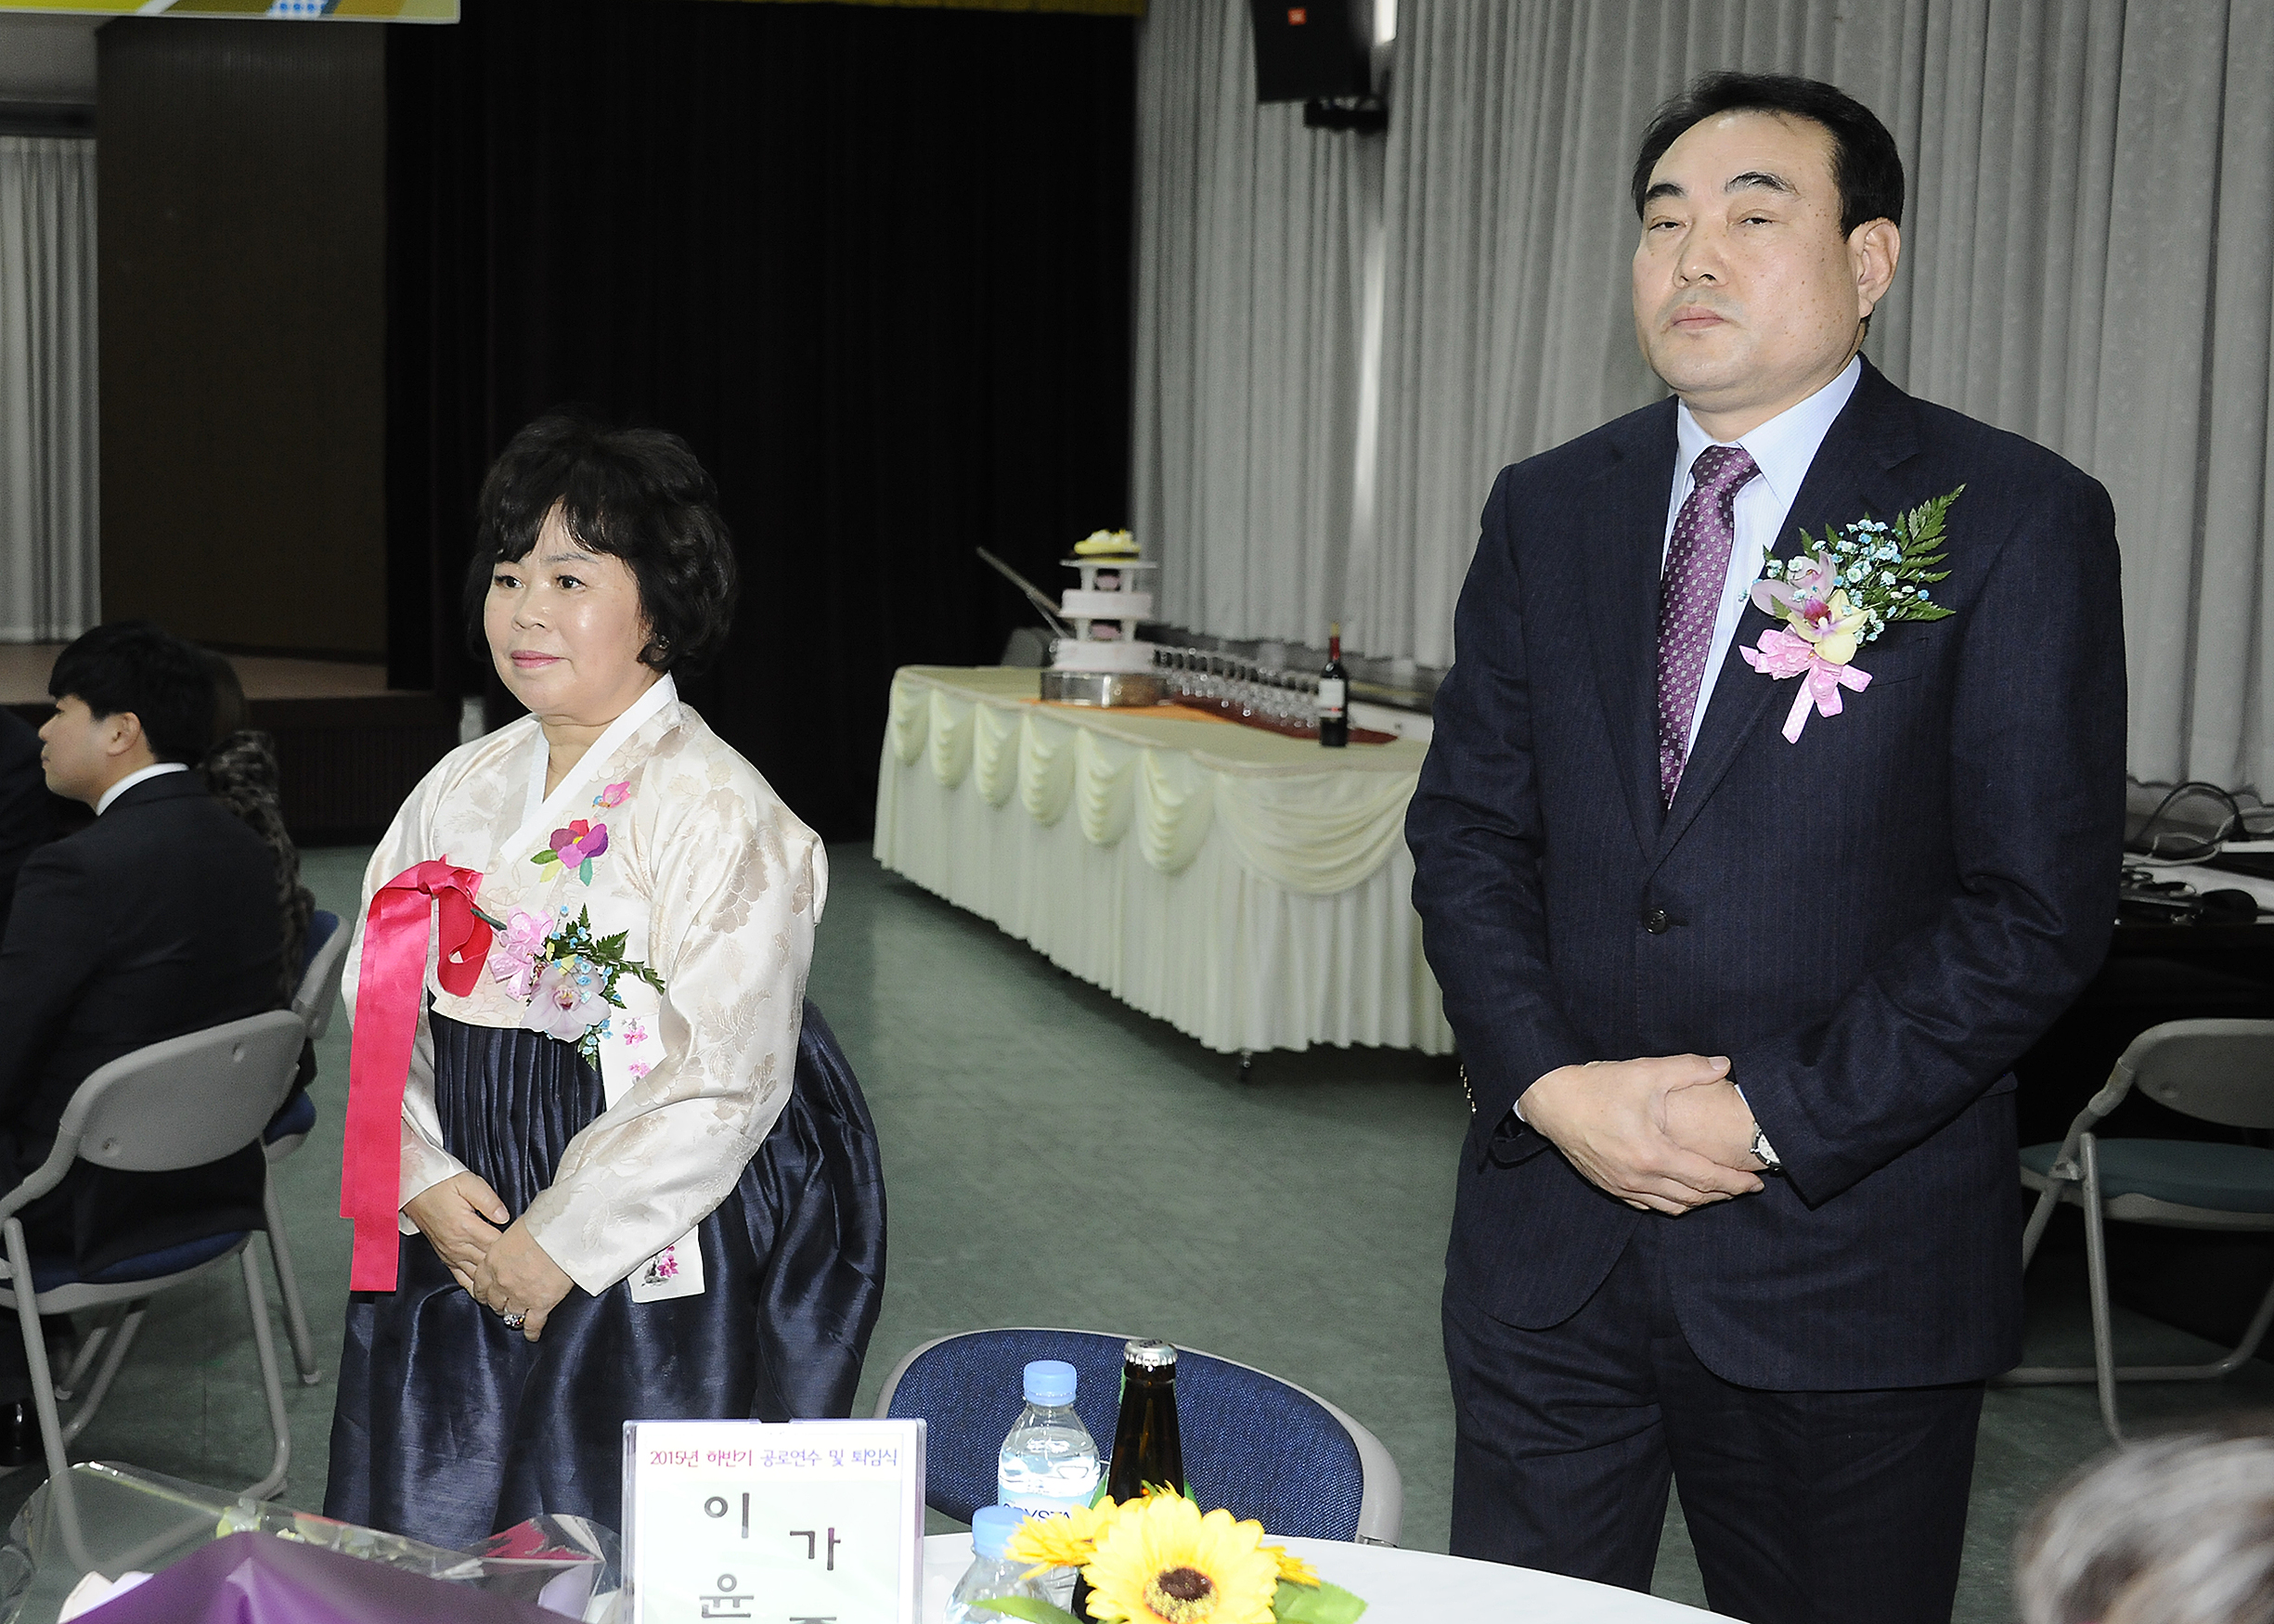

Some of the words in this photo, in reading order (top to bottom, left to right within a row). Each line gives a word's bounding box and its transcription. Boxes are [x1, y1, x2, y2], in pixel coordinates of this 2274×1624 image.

[650, 1450, 699, 1467] 2015년
[706, 1450, 752, 1467] 하반기
[760, 1448, 823, 1468] 공로연수
[829, 1449, 844, 1467] 및
[851, 1448, 898, 1467] 퇴임식
